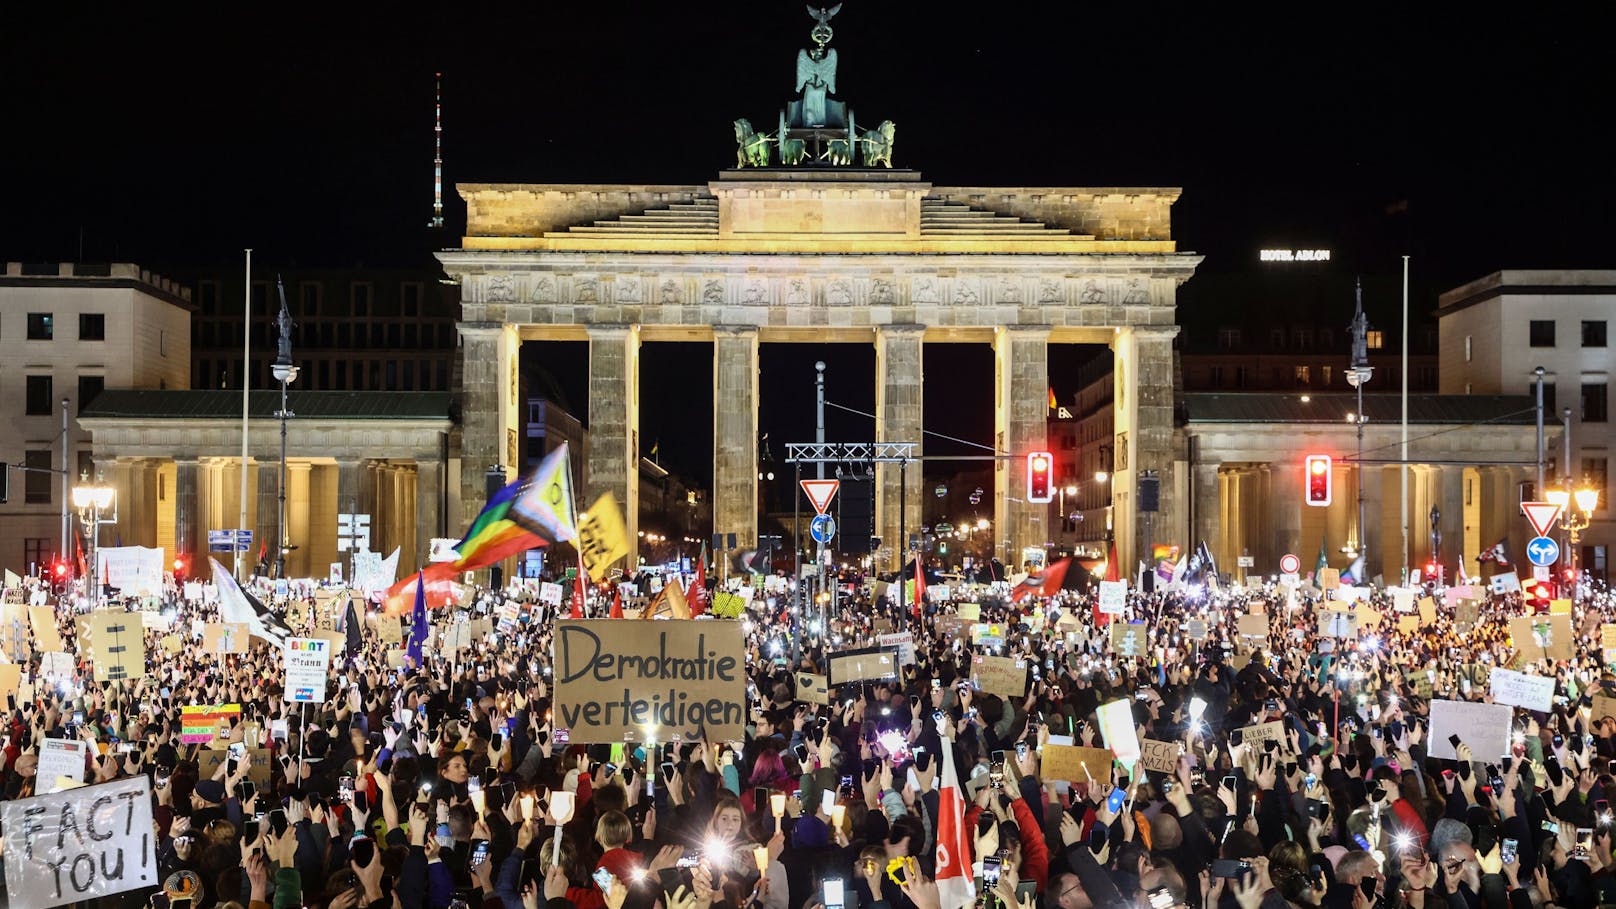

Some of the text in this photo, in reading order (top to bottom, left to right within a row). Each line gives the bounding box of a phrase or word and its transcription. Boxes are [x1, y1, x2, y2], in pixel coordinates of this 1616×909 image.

[1260, 249, 1330, 261] HOTEL ADLON
[291, 641, 324, 651] BUNT
[559, 625, 737, 684] Demokratie
[560, 689, 742, 740] verteidigen
[1244, 727, 1273, 739] LIEBER
[1144, 742, 1173, 758] FCK
[1141, 756, 1175, 771] NAZIS
[24, 790, 144, 860] FACT
